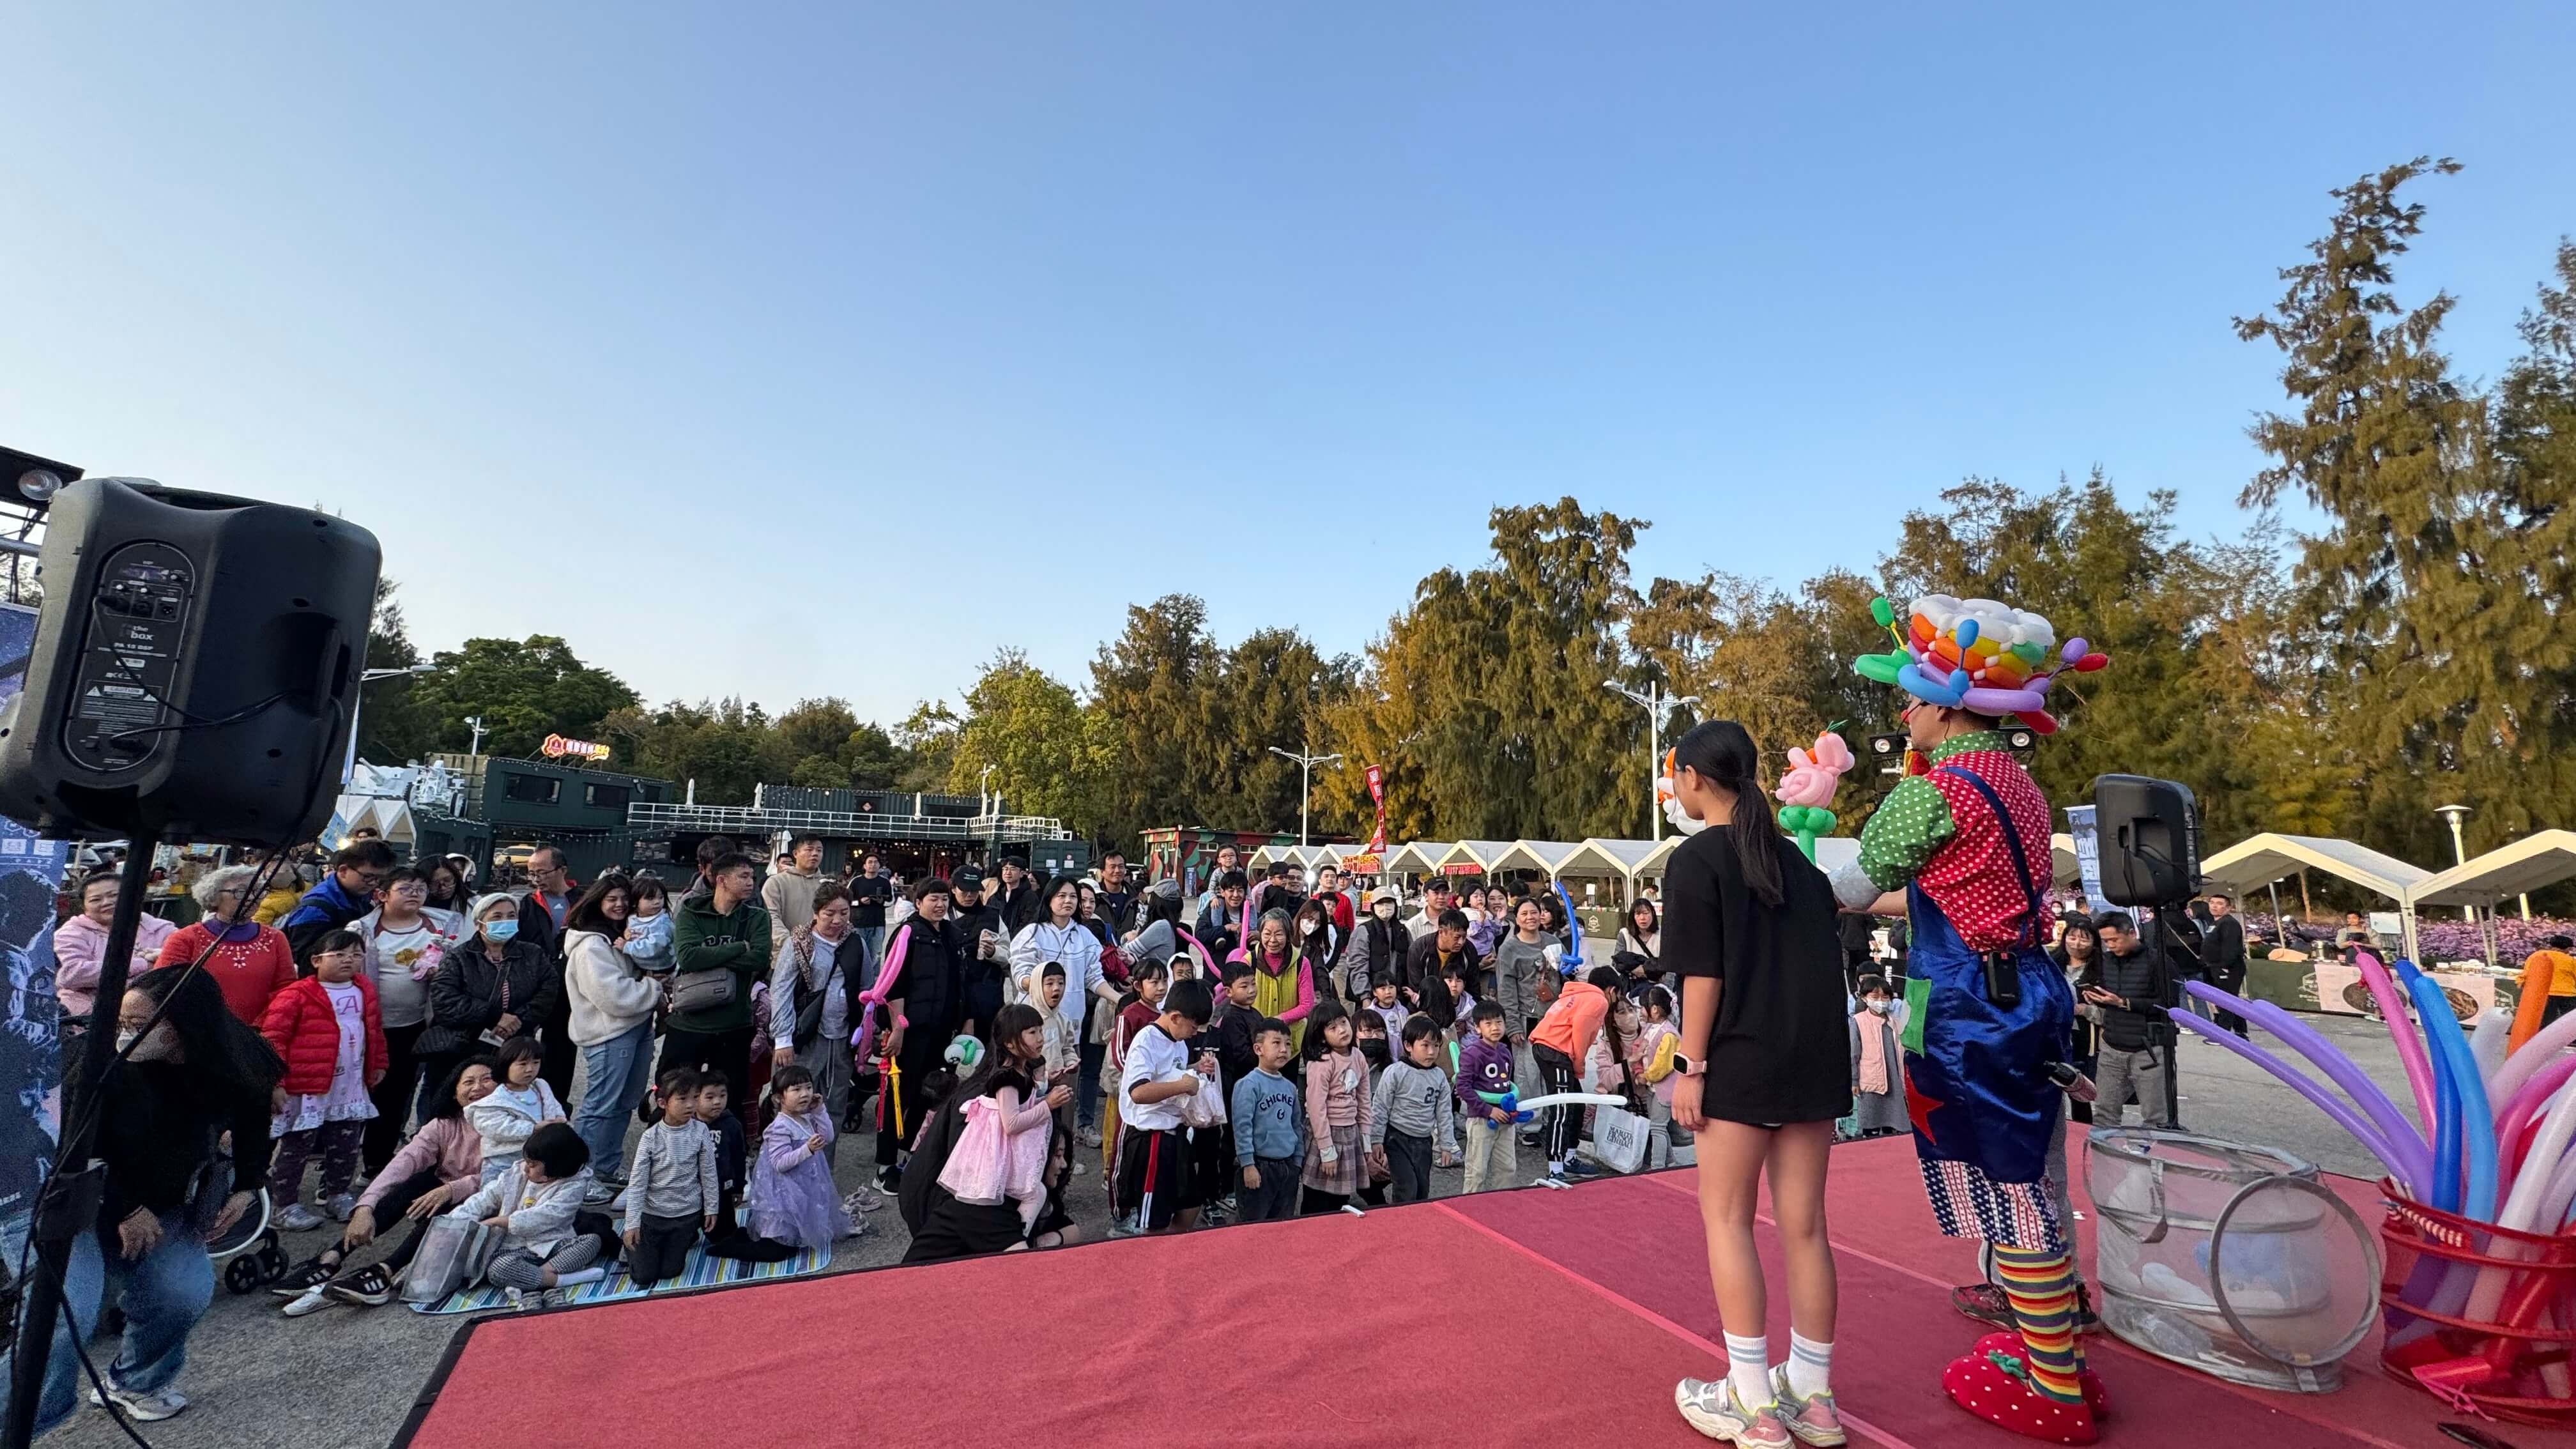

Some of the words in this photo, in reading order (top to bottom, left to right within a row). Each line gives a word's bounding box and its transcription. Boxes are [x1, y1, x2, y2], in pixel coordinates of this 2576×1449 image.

[130, 631, 154, 640] box
[1259, 1093, 1294, 1111] CHICKE
[709, 1130, 721, 1144] TS
